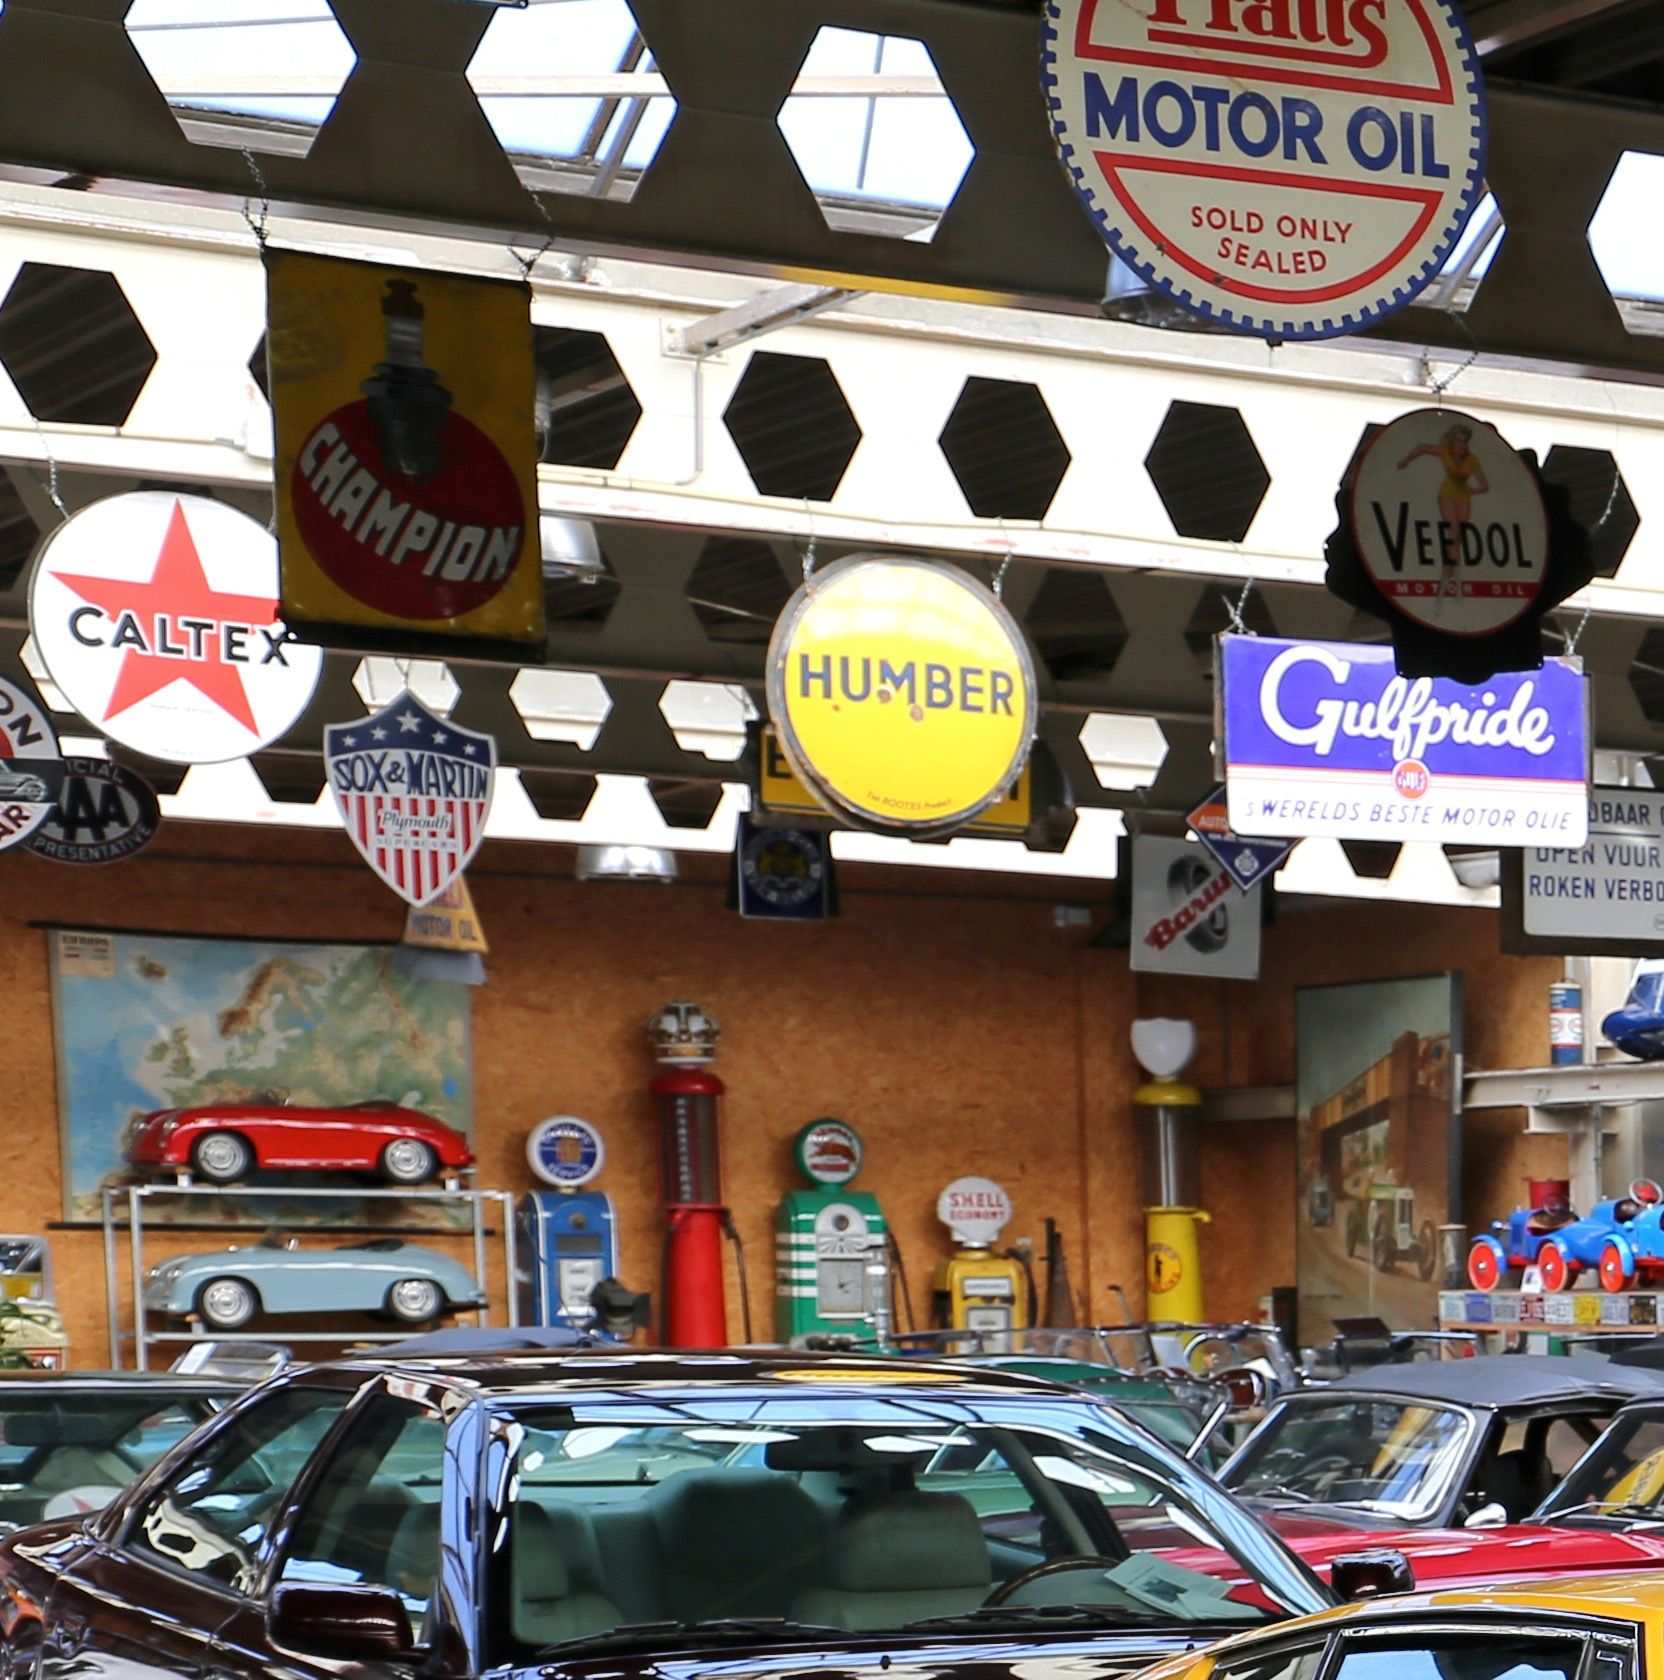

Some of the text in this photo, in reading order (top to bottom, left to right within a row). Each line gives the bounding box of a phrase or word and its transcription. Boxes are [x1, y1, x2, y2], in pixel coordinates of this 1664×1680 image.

[1084, 72, 1449, 178] MOTOR OIL
[1191, 205, 1352, 244] SOLD ONLY
[1217, 238, 1327, 273] SEALED
[300, 422, 519, 582] CHAMPION
[1397, 581, 1524, 595] MOTOR OIL
[69, 606, 290, 667] CALTEX
[800, 653, 1014, 718] HUMBER
[1259, 644, 1556, 761] Gulfpride
[66, 759, 122, 783] ICIAL
[333, 752, 488, 799] SOX & MARTIN
[382, 811, 450, 831] Plymouth
[1262, 799, 1571, 830] WERELDS BESTE MOTOR OLIE
[1588, 801, 1650, 827] DBAAR
[33, 824, 153, 861] PRESENTATIVE
[1536, 847, 1595, 865] OPEN
[1604, 844, 1661, 869] VUUR
[1529, 875, 1596, 899] ROKEN
[411, 912, 478, 942] MOTOR OIL
[950, 1193, 1003, 1208] SHELL
